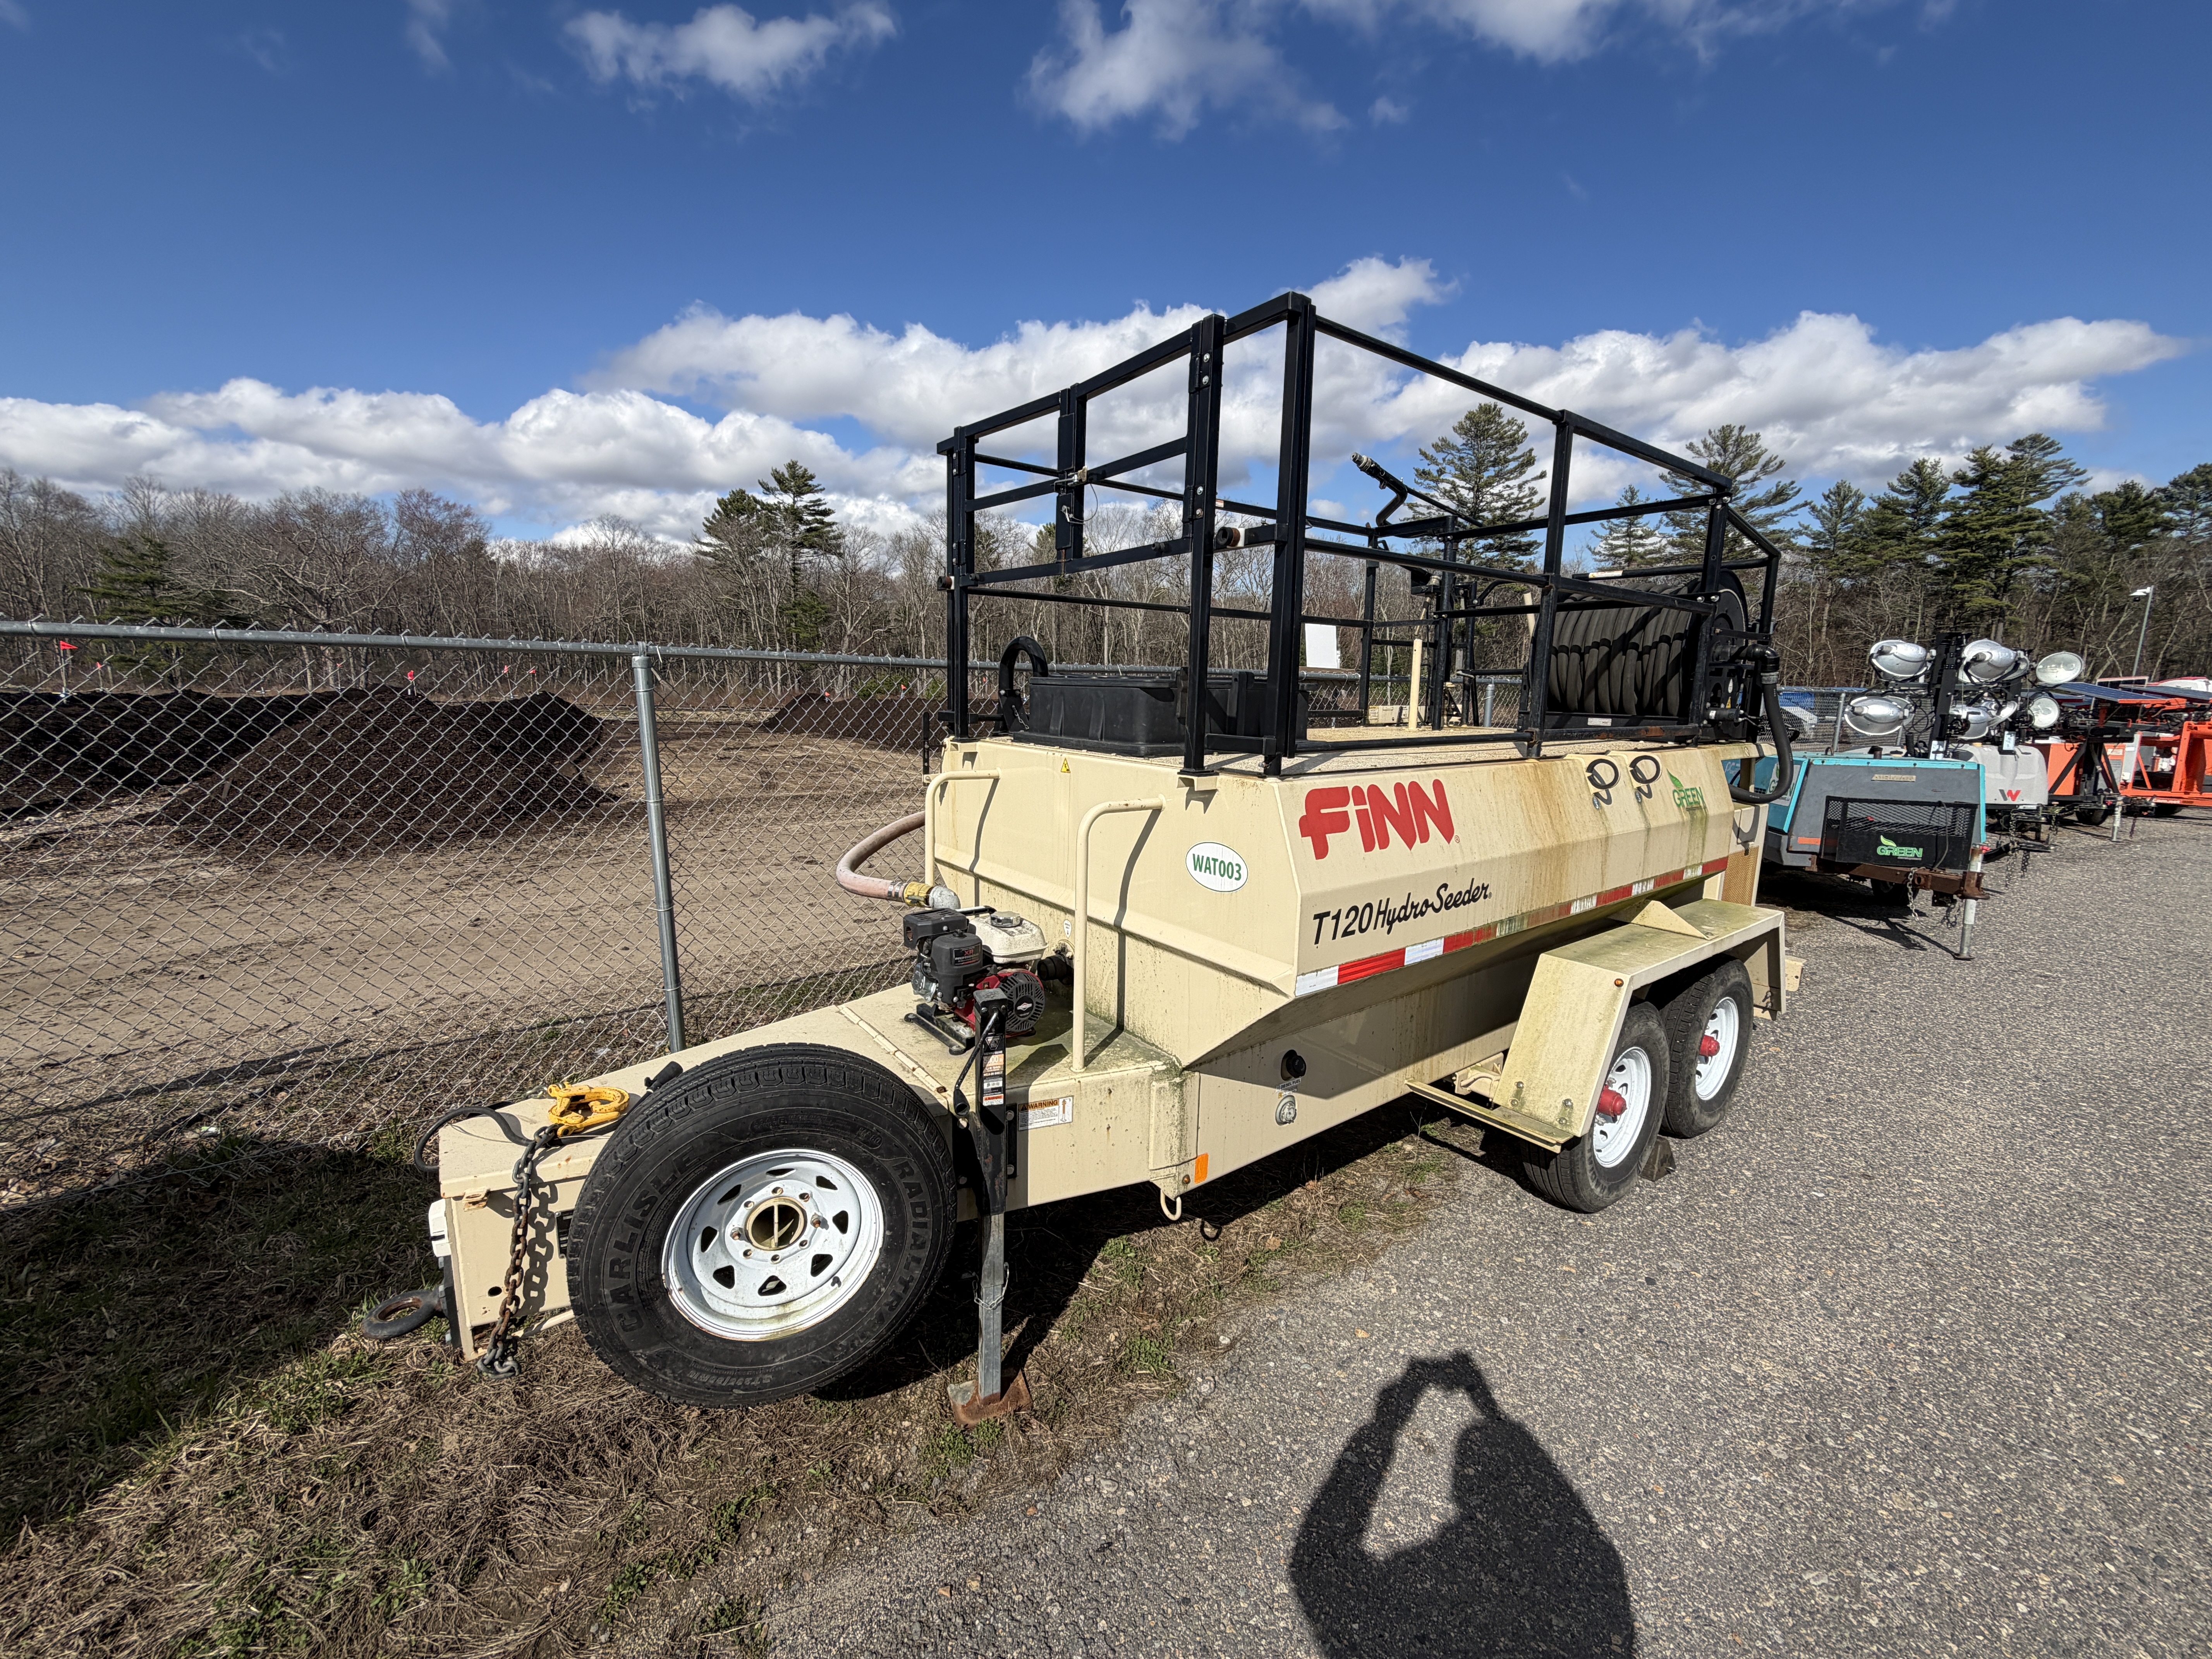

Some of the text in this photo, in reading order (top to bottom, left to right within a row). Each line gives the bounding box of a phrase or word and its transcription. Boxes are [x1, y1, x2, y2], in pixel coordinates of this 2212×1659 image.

[1673, 786, 1706, 809] GREEN
[1877, 845, 1923, 857] GREEN
[1192, 853, 1242, 881] WAT003
[1028, 1100, 1058, 1109] WARNING
[893, 1160, 928, 1271] RADIAL
[609, 1146, 701, 1333] CARLISLE
